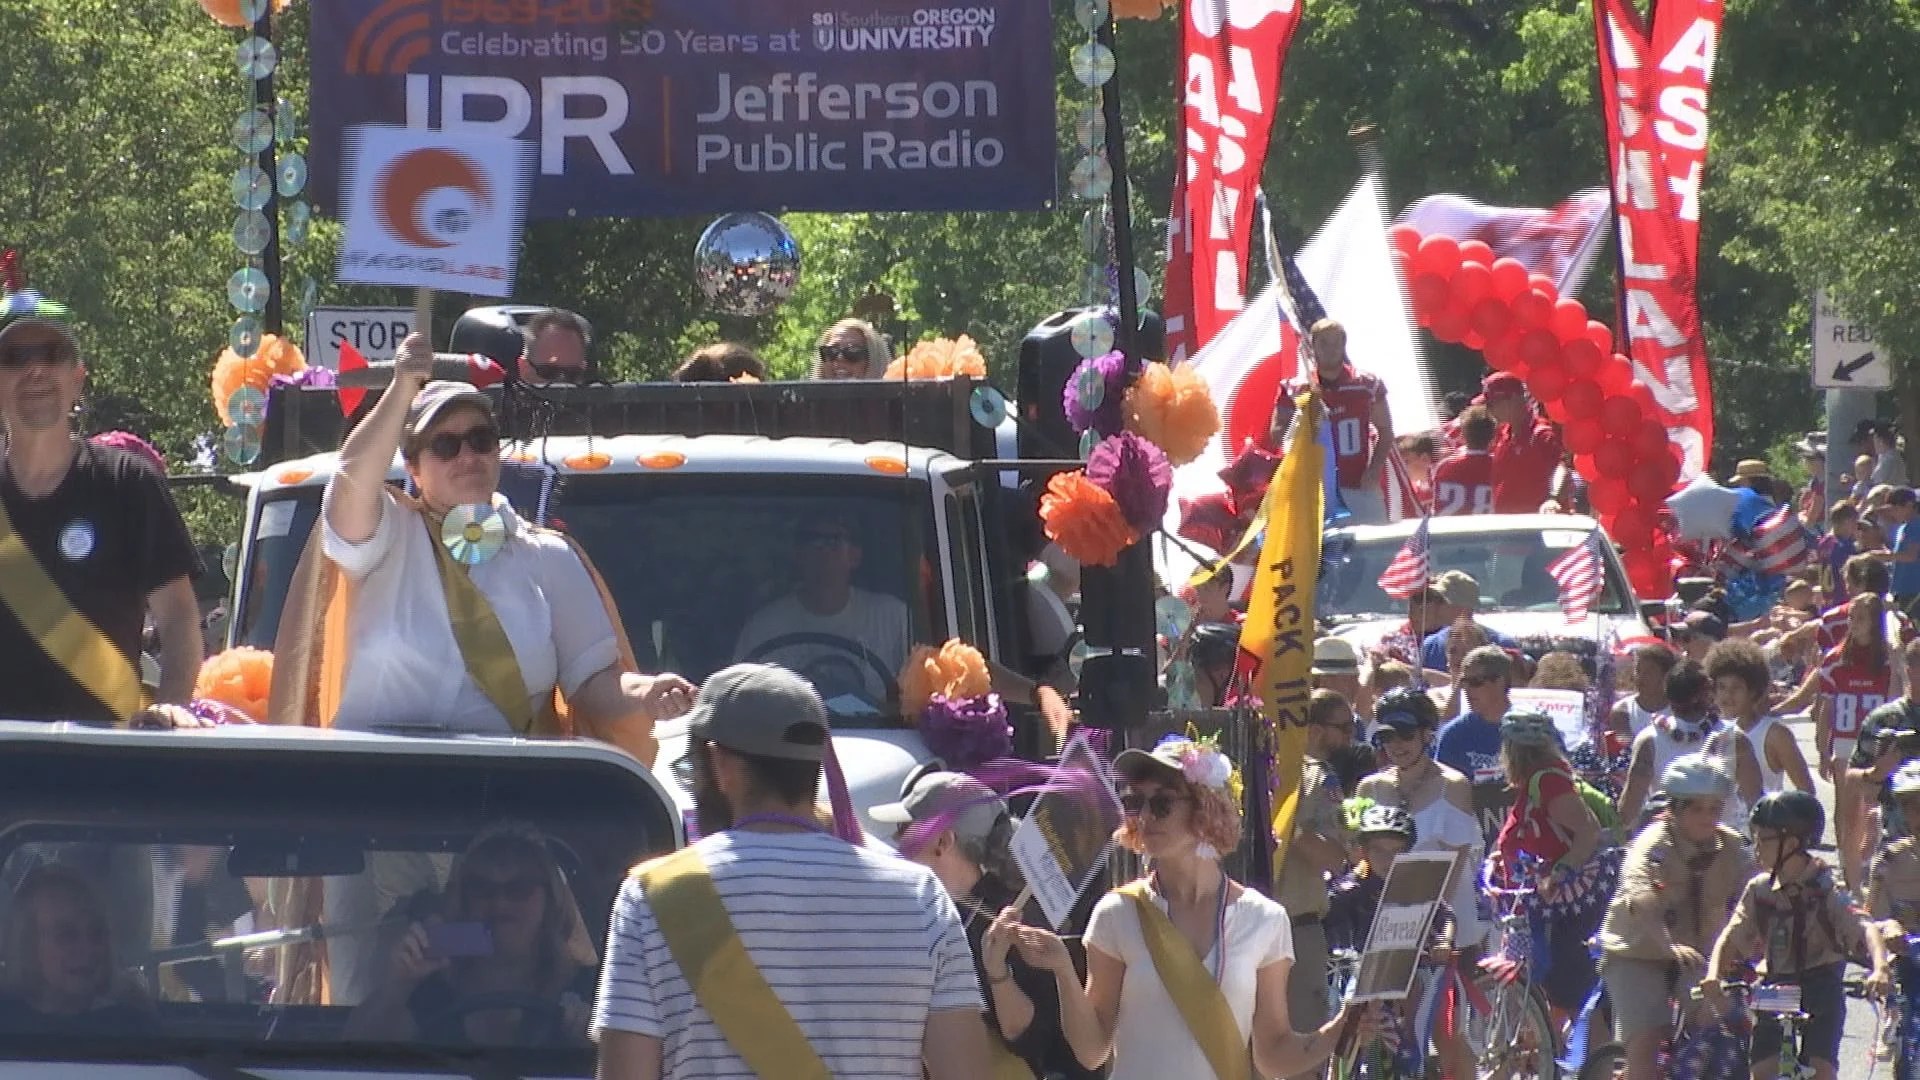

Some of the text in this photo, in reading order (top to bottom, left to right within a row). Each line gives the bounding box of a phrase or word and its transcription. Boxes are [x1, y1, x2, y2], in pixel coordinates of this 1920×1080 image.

[840, 11, 911, 27] Southern
[913, 8, 996, 25] OREGON
[441, 27, 801, 61] Celebrating 50 Years at
[840, 25, 994, 51] UNIVERSITY
[697, 71, 998, 123] Jefferson
[697, 129, 1004, 173] Public Radio
[330, 320, 410, 351] STOP
[1833, 325, 1874, 343] RED
[1270, 556, 1309, 731] PACK 112
